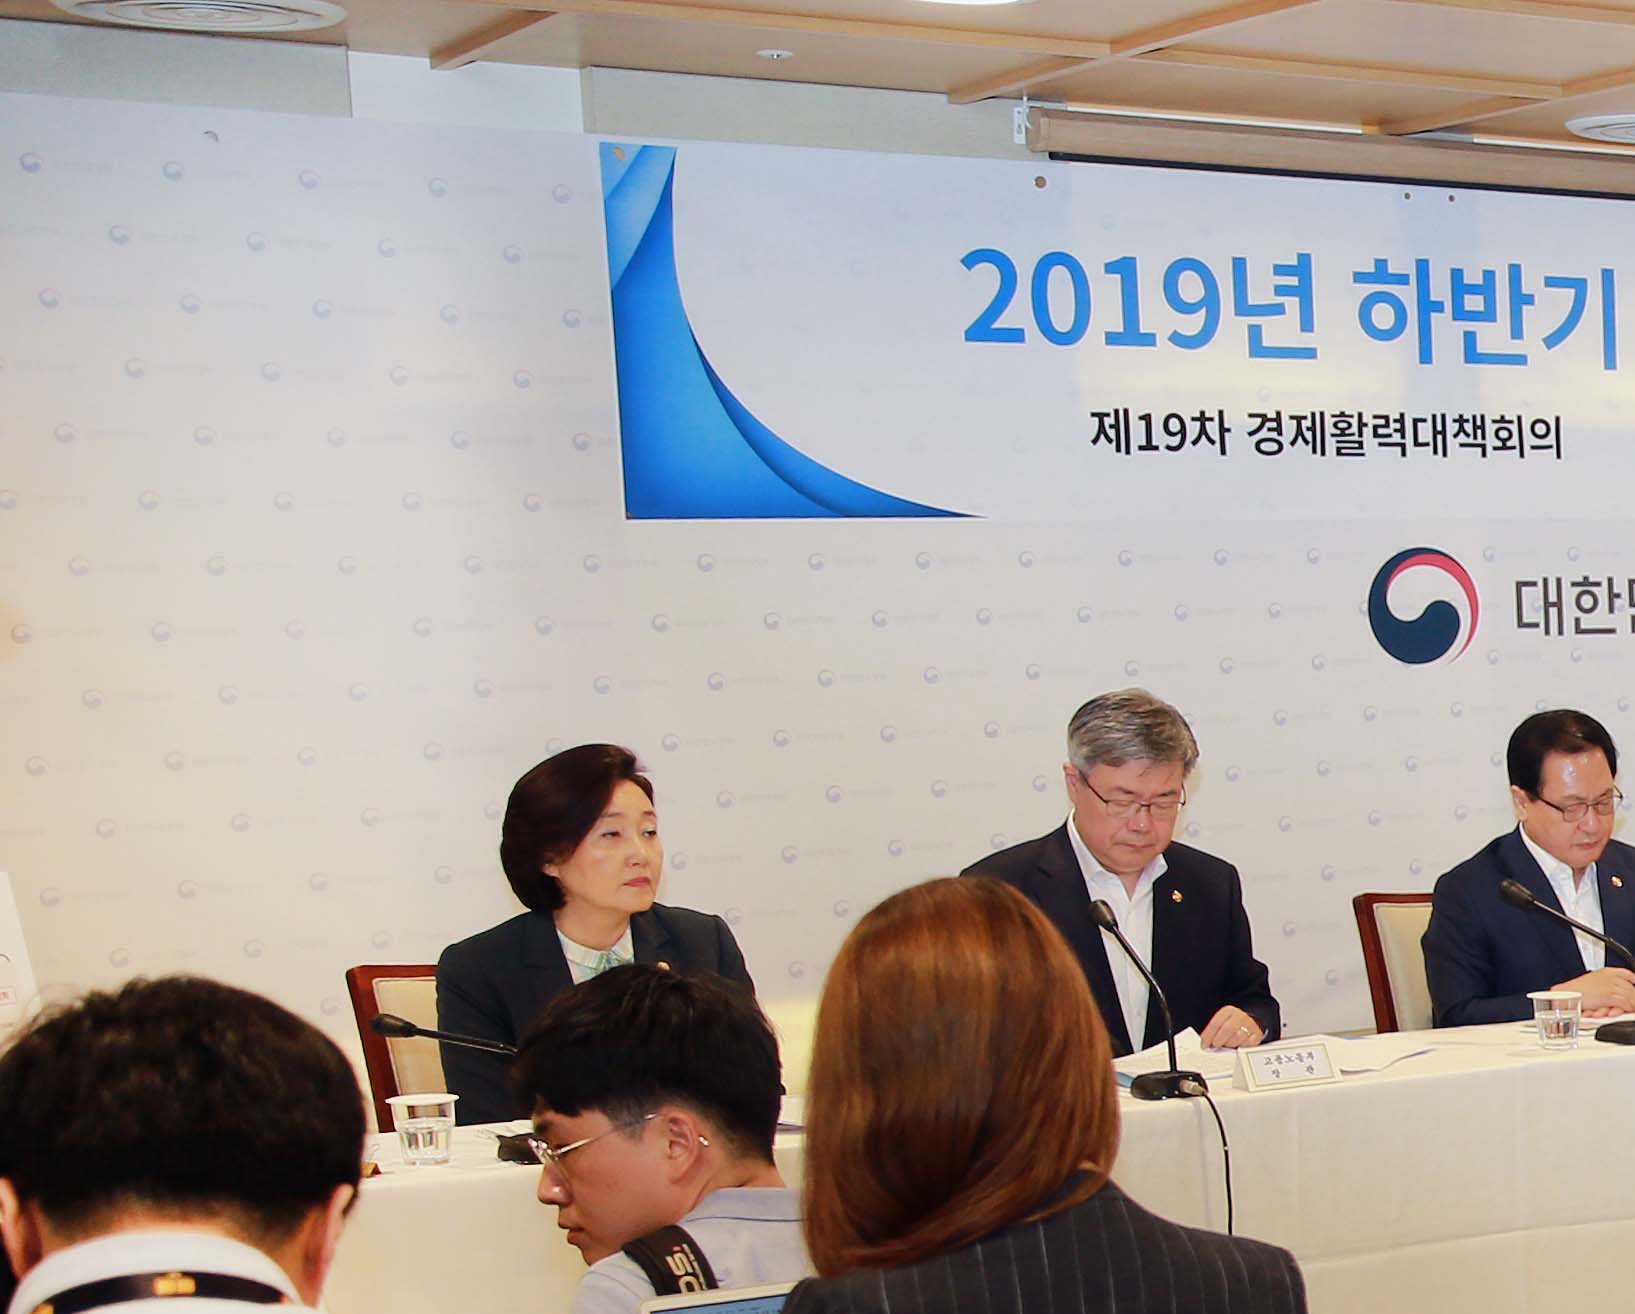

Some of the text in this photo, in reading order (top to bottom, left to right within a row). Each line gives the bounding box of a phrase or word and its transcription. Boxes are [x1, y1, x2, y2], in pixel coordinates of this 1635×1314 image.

[961, 248, 1317, 358] 2019년
[1353, 257, 1616, 369] 하반기
[1091, 408, 1562, 460] 제19차 경제활력대책회의
